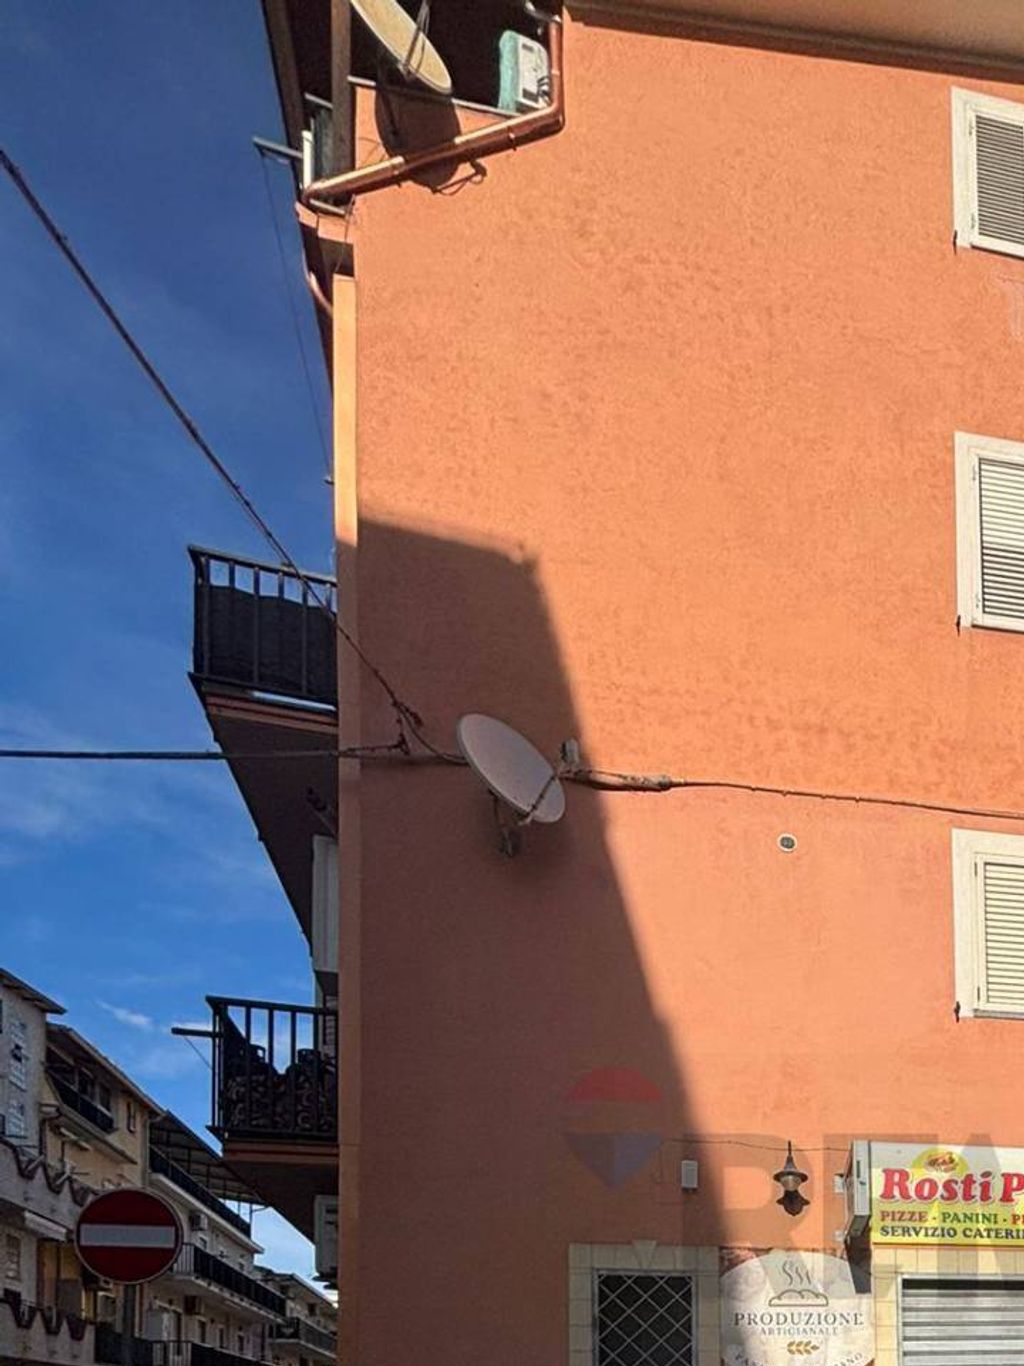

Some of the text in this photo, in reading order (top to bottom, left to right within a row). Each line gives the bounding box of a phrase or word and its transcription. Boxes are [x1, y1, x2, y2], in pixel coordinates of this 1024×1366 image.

[880, 1167, 993, 1202] Rosti
[880, 1211, 928, 1222] PIZZE
[942, 1212, 999, 1225] PANINI
[880, 1225, 957, 1239] SERVIZIO
[734, 1312, 864, 1326] PRODUZIONE
[761, 1327, 838, 1336] ARTIGIANALE
